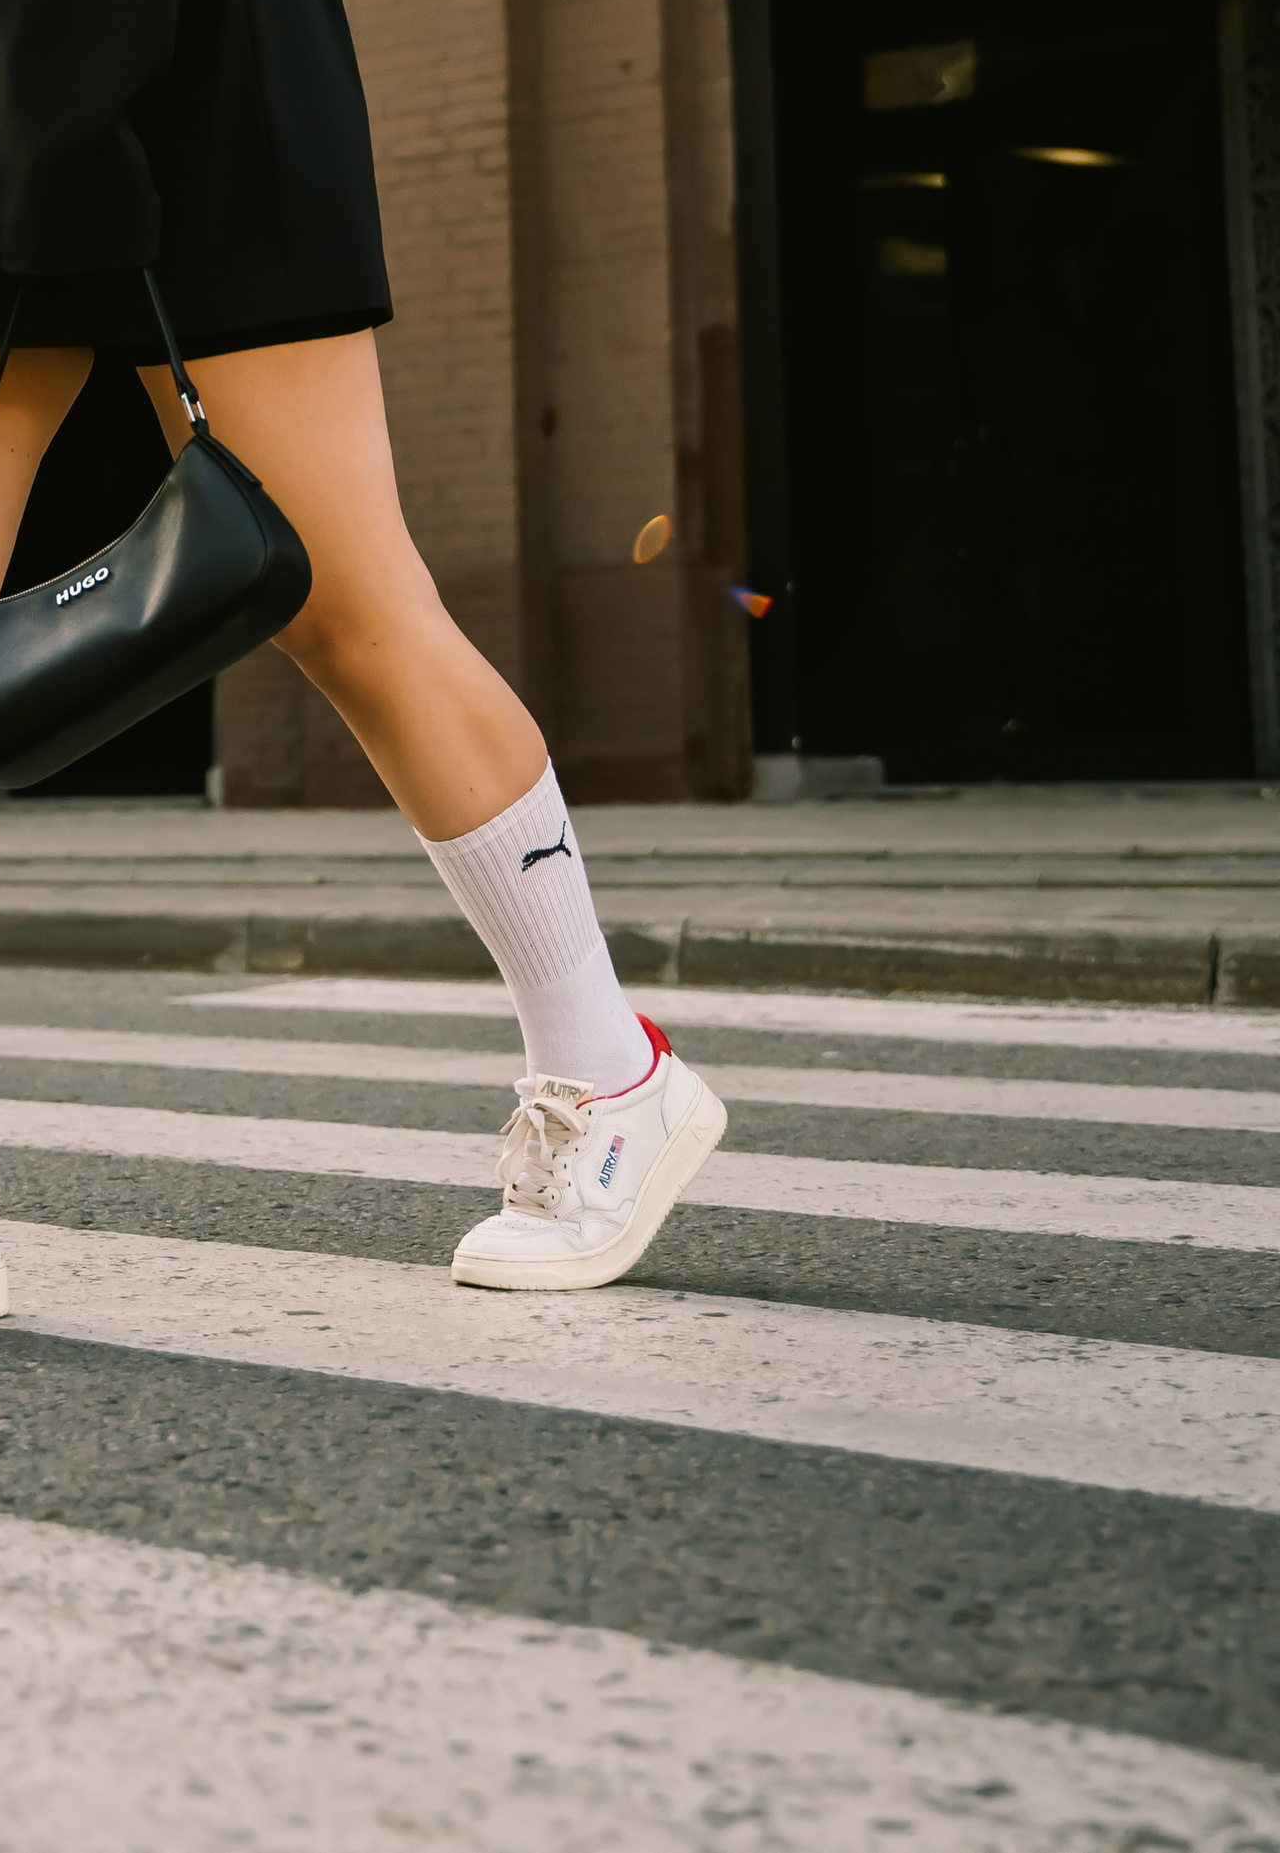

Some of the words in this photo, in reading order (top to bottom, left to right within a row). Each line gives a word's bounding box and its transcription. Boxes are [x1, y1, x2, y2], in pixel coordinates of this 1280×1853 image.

[56, 567, 109, 605] HUGO
[540, 1079, 589, 1101] AUTRY
[598, 1151, 617, 1190] AUTRY
